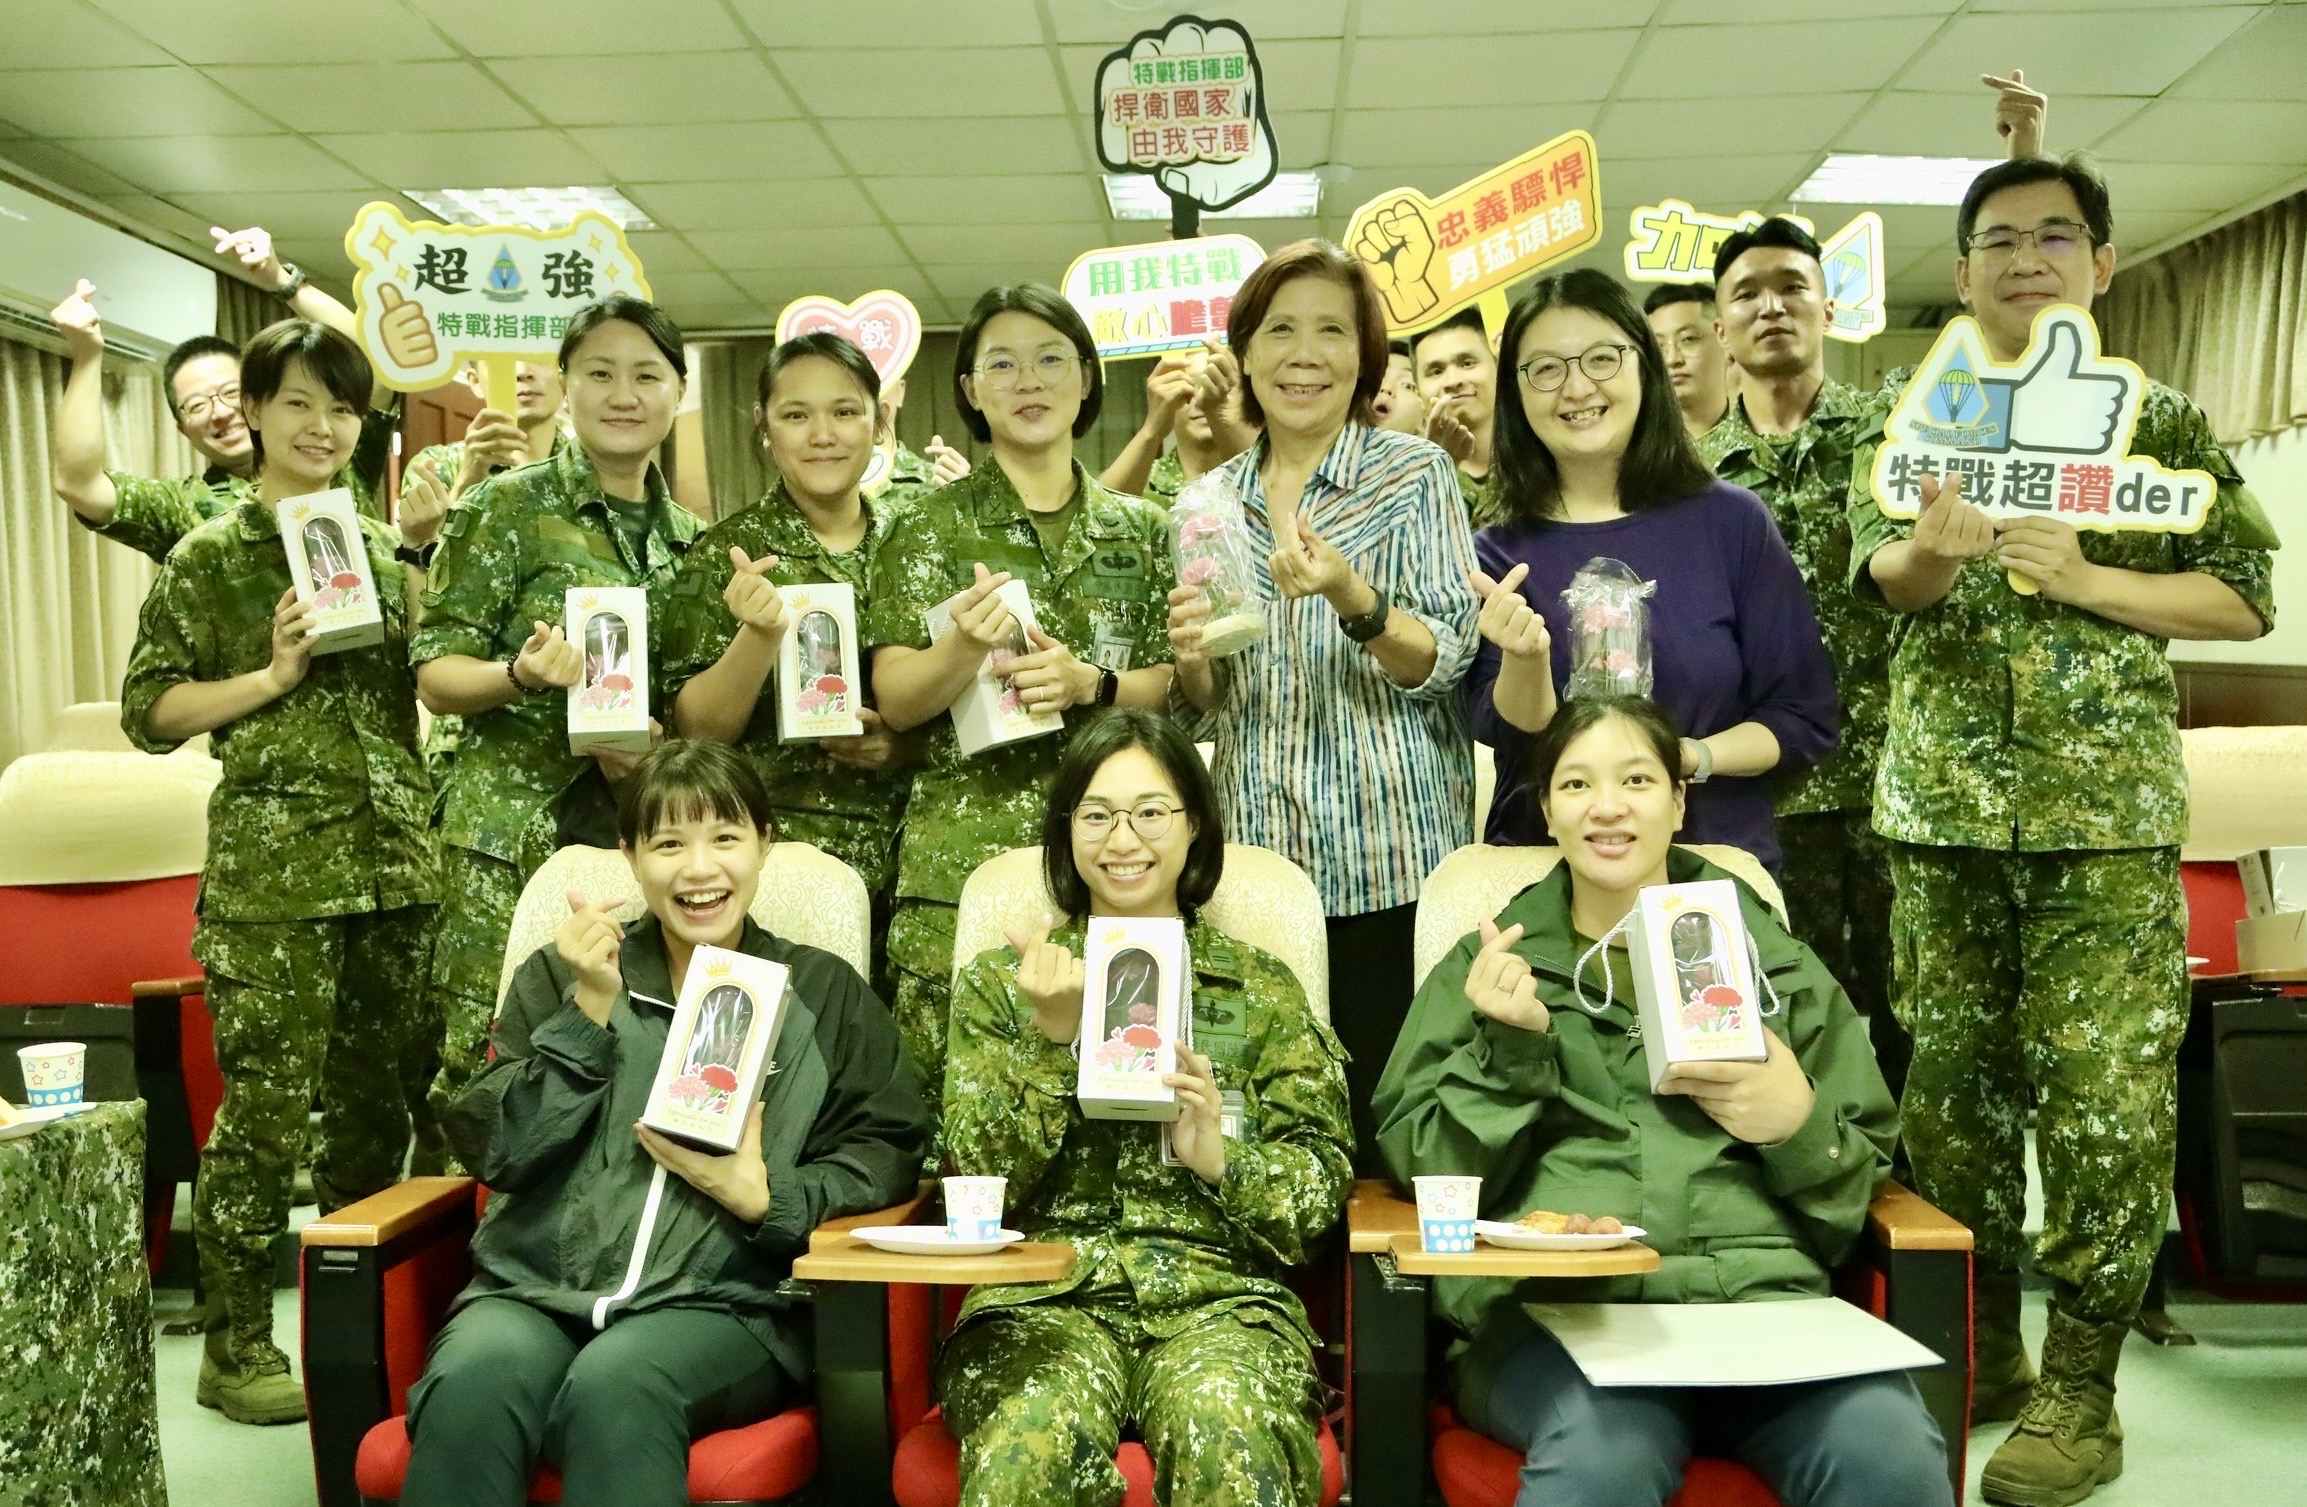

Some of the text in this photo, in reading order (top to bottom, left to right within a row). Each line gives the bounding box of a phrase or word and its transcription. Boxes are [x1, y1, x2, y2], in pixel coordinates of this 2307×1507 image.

[1133, 56, 1246, 85] 特戰指揮部
[1113, 88, 1232, 122] 捍衛國家
[1132, 124, 1250, 158] 由我守護
[1436, 151, 1586, 250] 忠義驃悍
[1446, 198, 1586, 292] 勇猛頑強
[1637, 210, 1760, 273] 加
[1088, 247, 1244, 297] 用我特戰
[436, 311, 569, 340] 特戰指揮部
